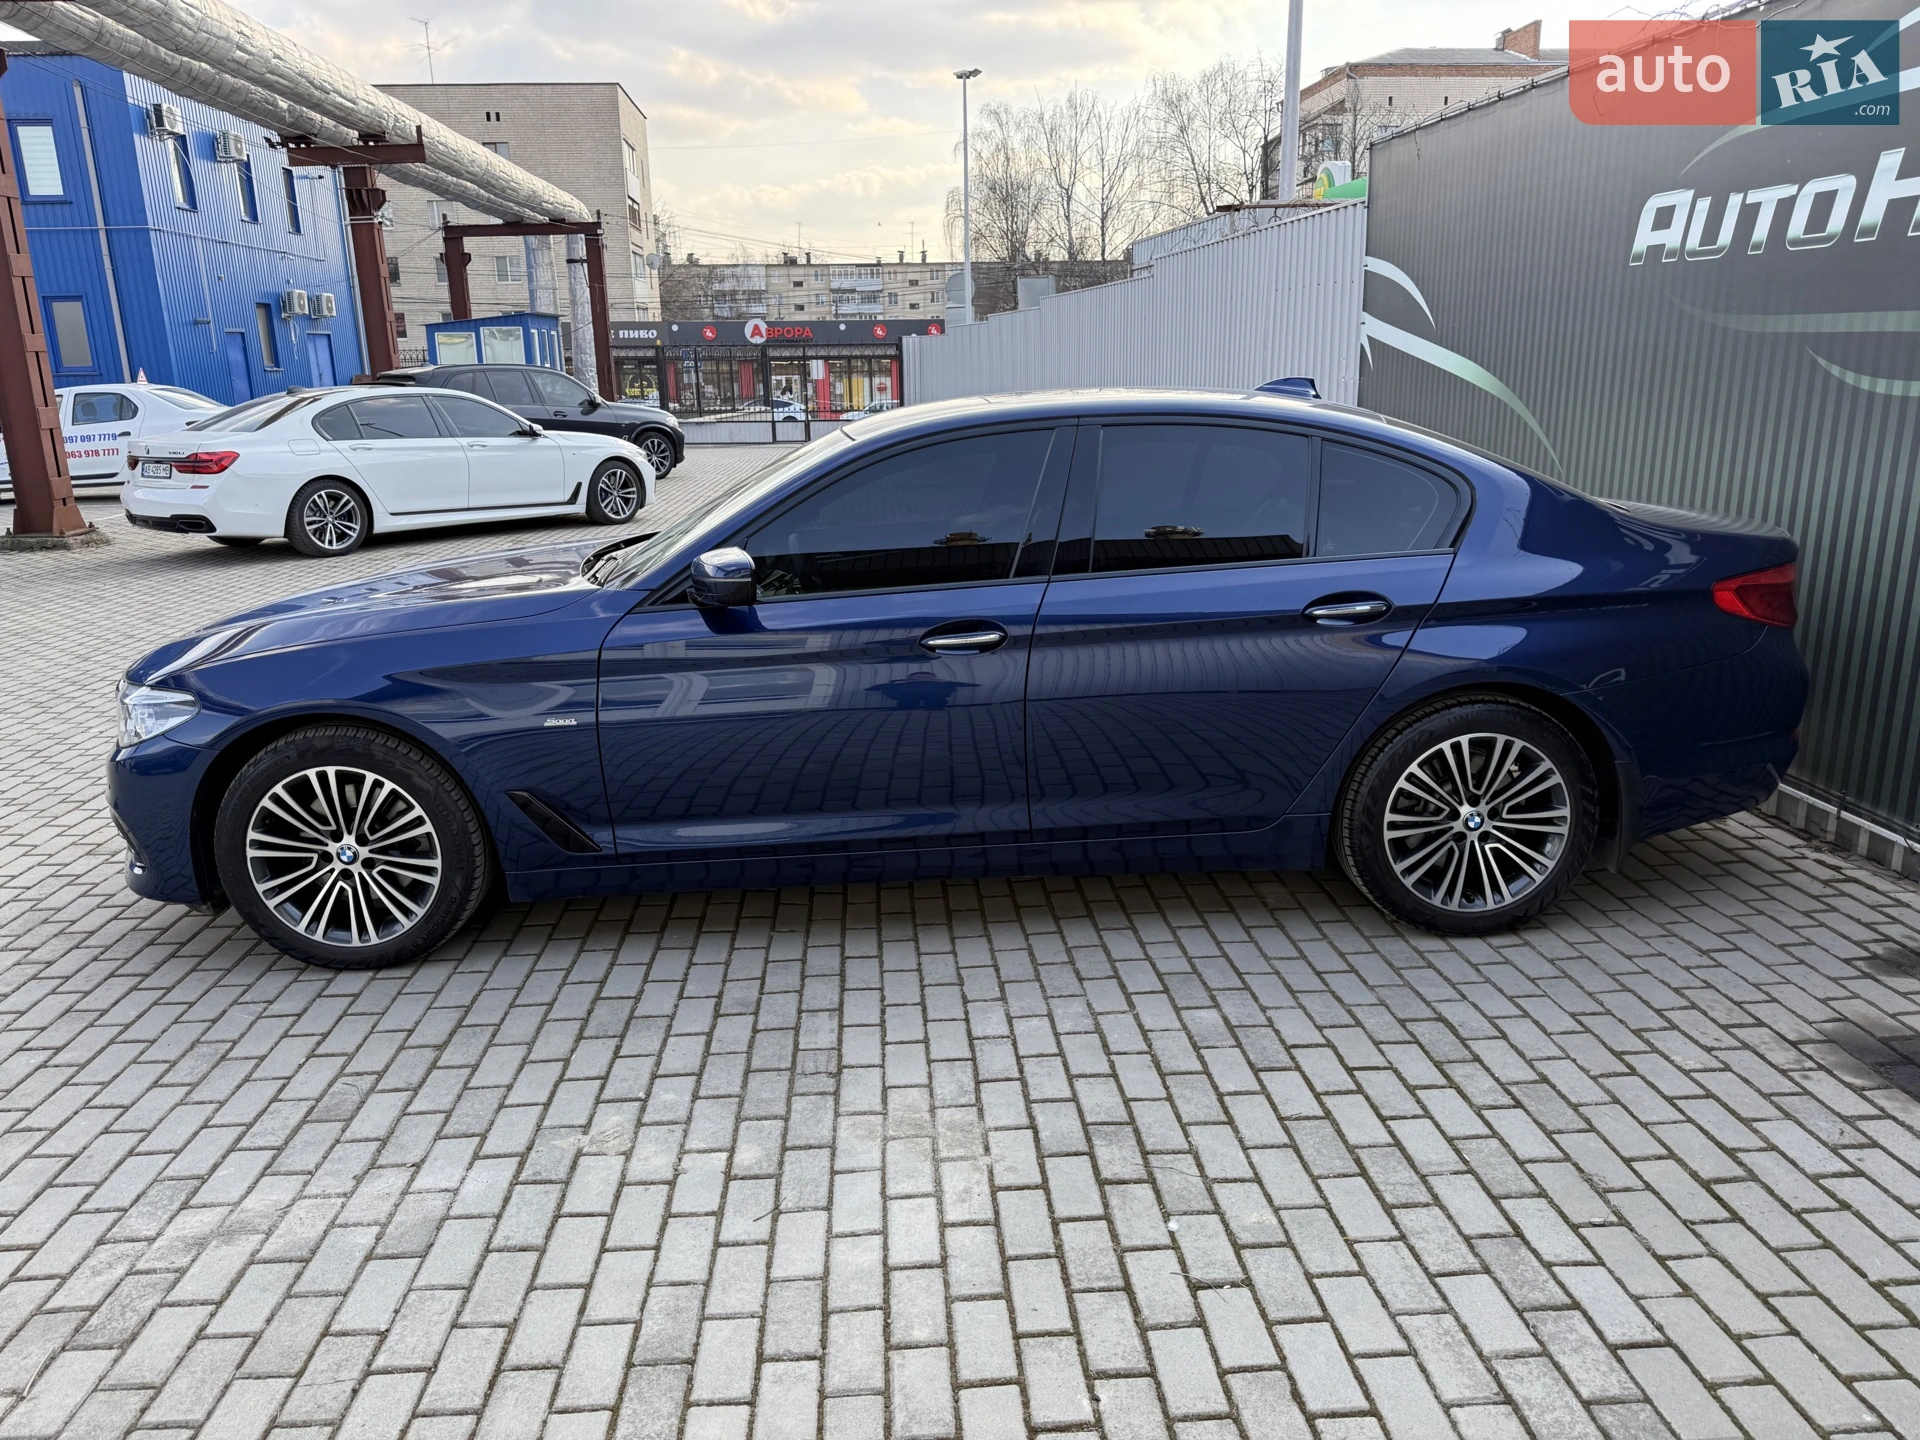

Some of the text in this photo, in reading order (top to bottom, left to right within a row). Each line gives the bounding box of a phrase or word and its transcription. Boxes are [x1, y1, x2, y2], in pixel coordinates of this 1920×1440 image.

[750, 323, 814, 339] АВРОРА
[80, 434, 96, 443] 097
[97, 432, 118, 442] 7779
[65, 447, 119, 459] 063 978 7777
